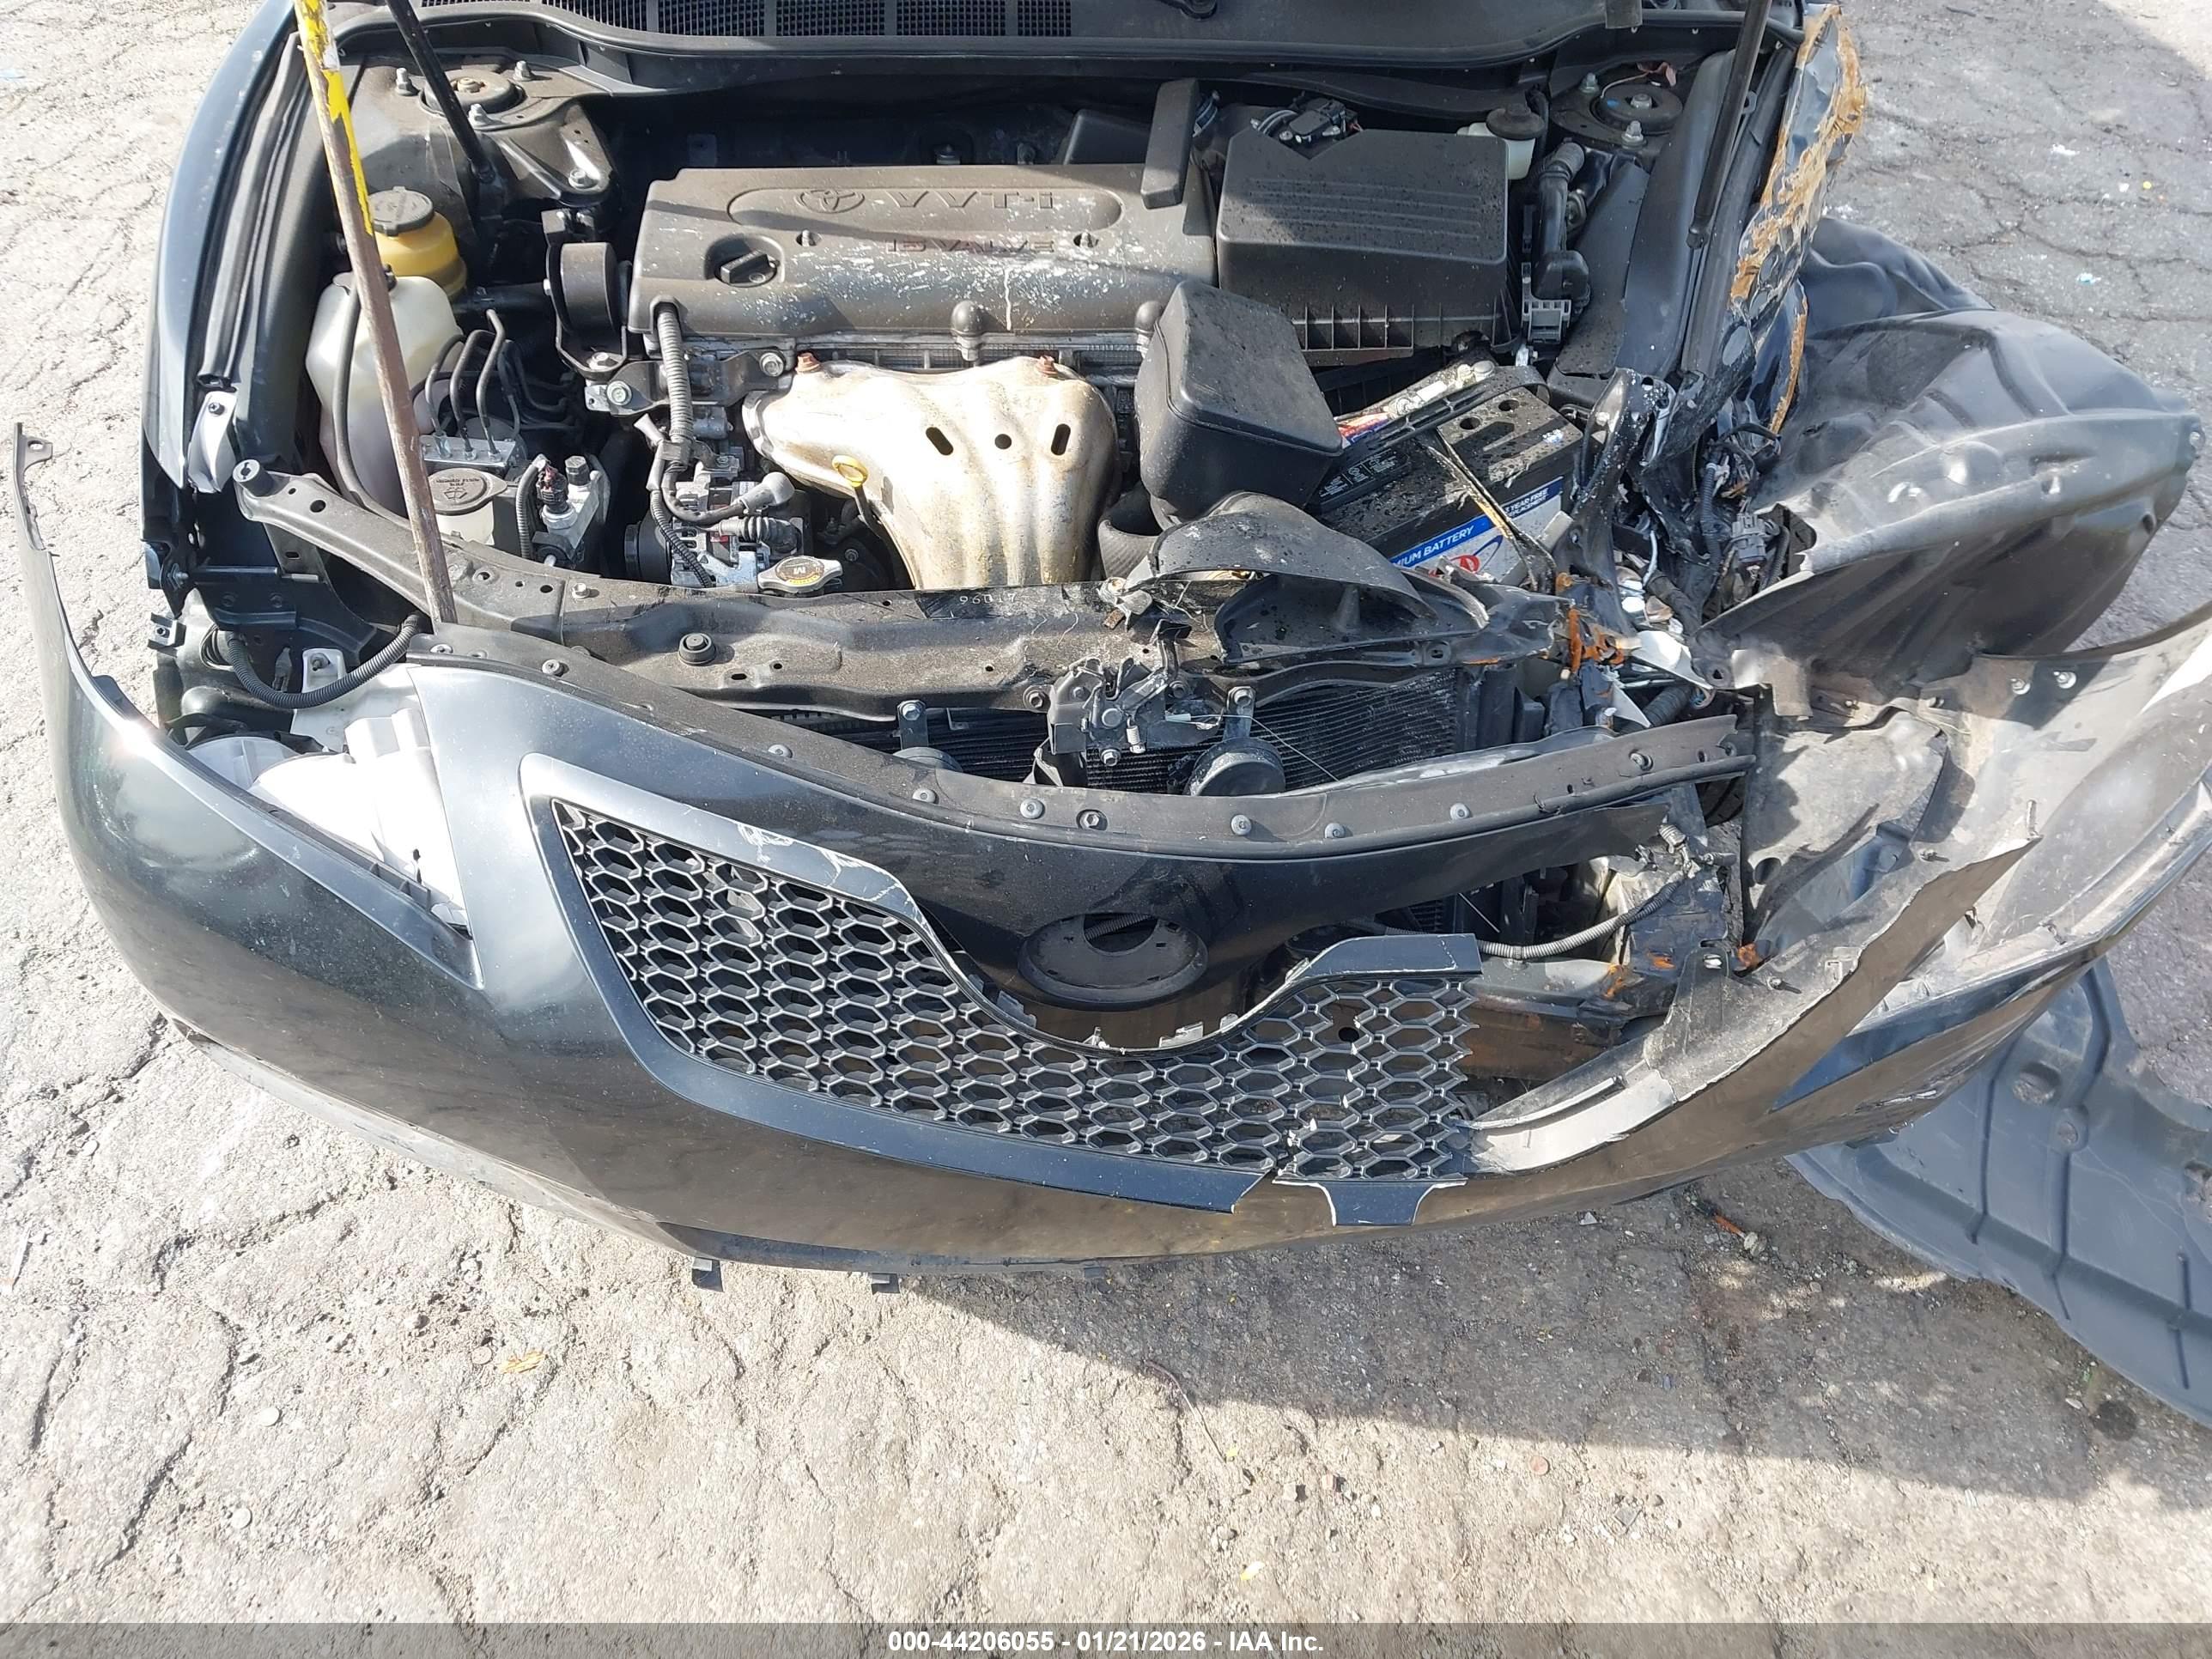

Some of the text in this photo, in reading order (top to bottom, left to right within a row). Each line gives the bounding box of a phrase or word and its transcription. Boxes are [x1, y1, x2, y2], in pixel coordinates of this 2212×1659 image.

[1510, 498, 1530, 511] YEAR
[1530, 488, 1549, 501] FREE
[1423, 526, 1474, 556] BATTERY
